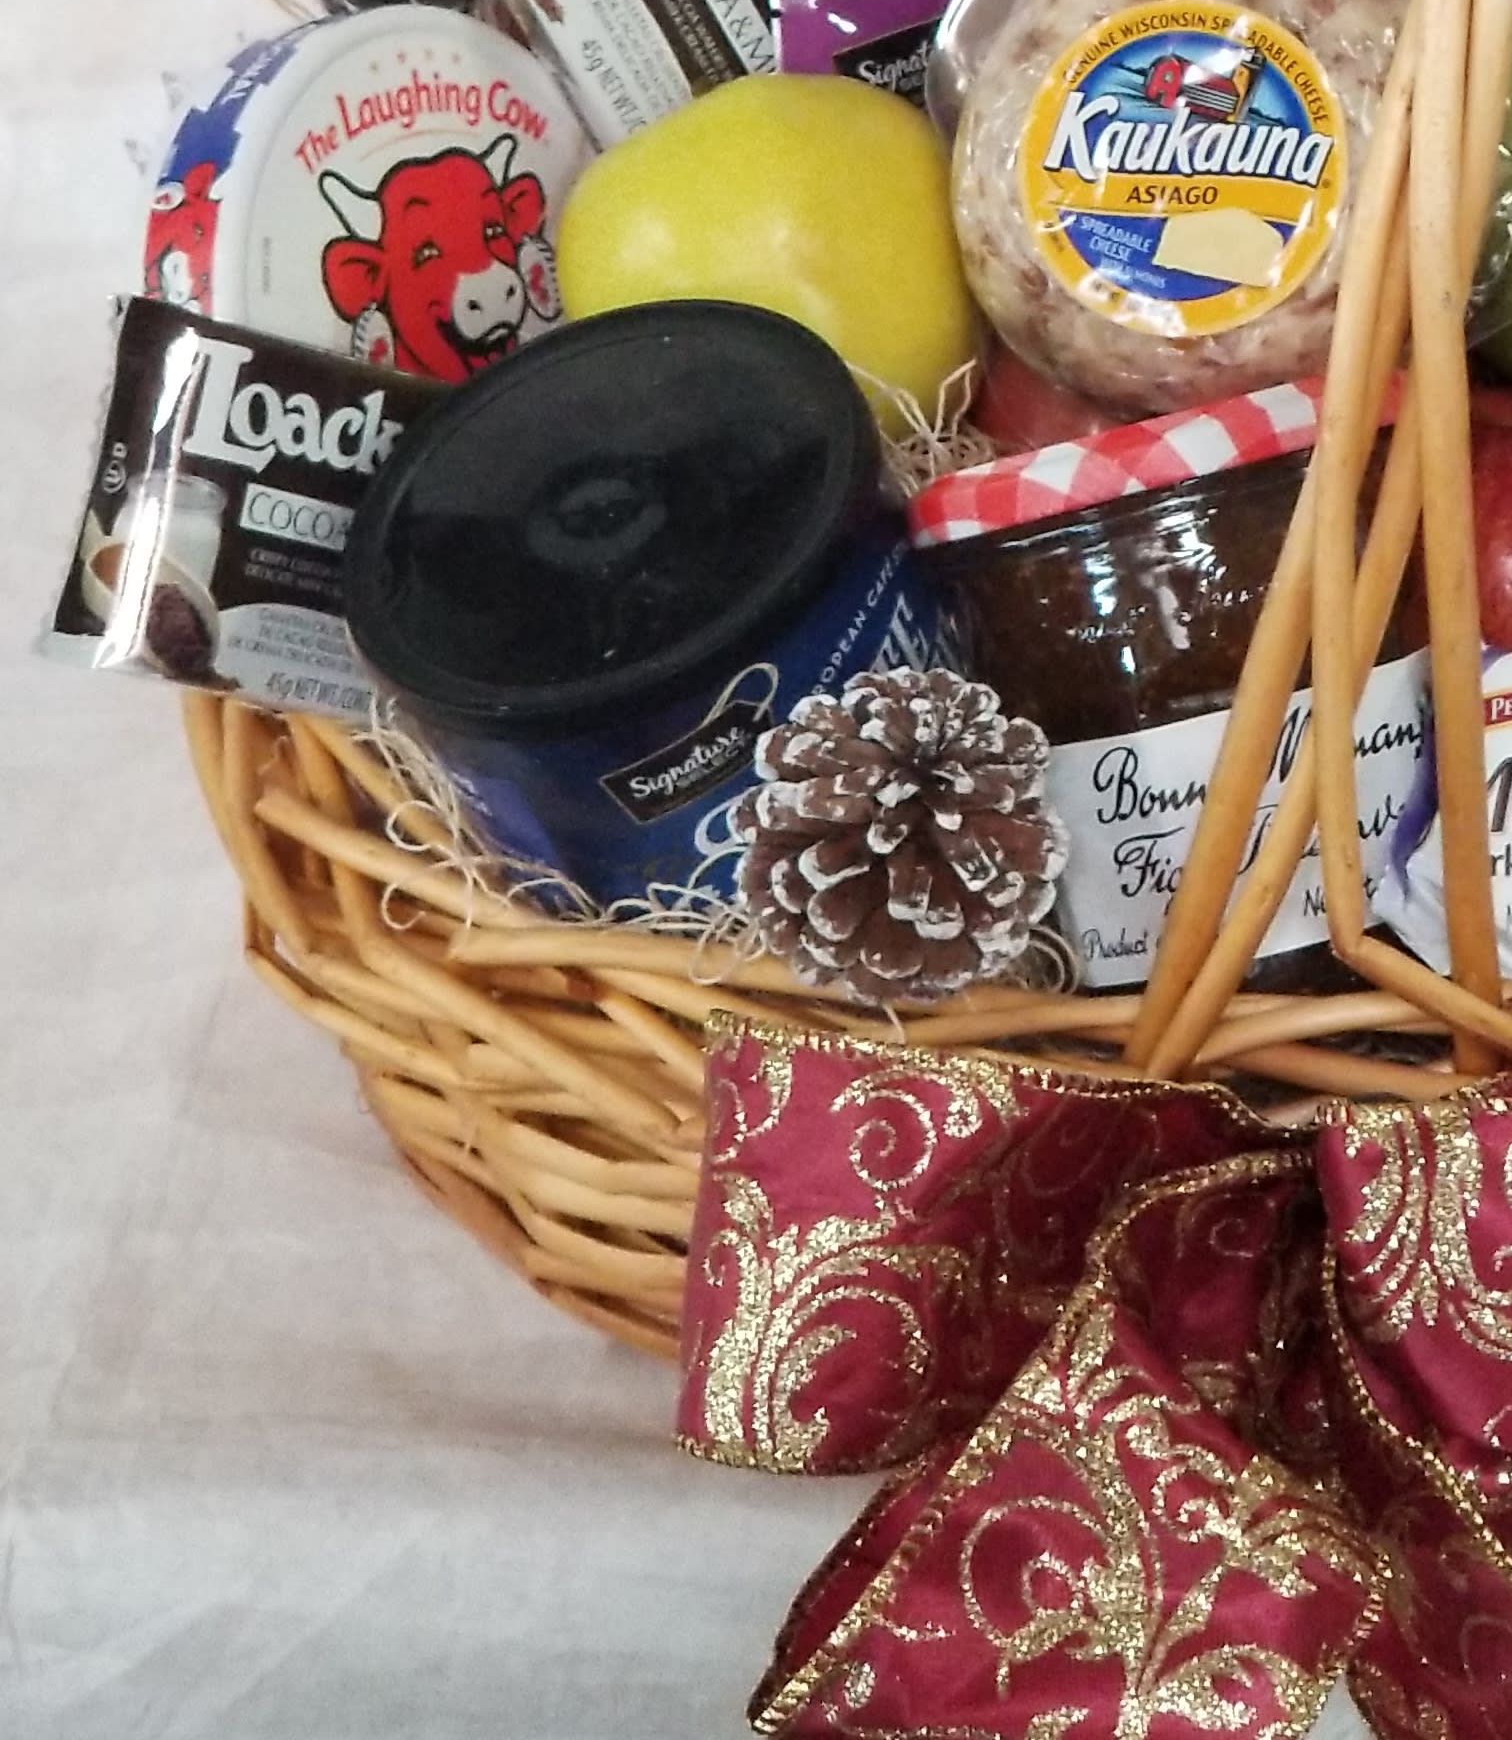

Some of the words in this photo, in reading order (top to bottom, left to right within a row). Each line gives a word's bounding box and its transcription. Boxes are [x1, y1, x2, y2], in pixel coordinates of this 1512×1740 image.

[581, 39, 602, 72] 45g
[1120, 11, 1206, 39] WISCONSIN
[1212, 15, 1297, 73] SPADABLE
[1294, 71, 1329, 125] CHEESE
[294, 125, 338, 174] The
[336, 69, 481, 139] Laughing
[487, 79, 548, 140] Cow
[1044, 90, 1334, 188] Kaukauna
[1126, 185, 1219, 205] ASIAGO
[1080, 214, 1153, 253] SPREADABLE
[1089, 235, 1133, 261] CHEESE
[629, 725, 742, 800] Signature
